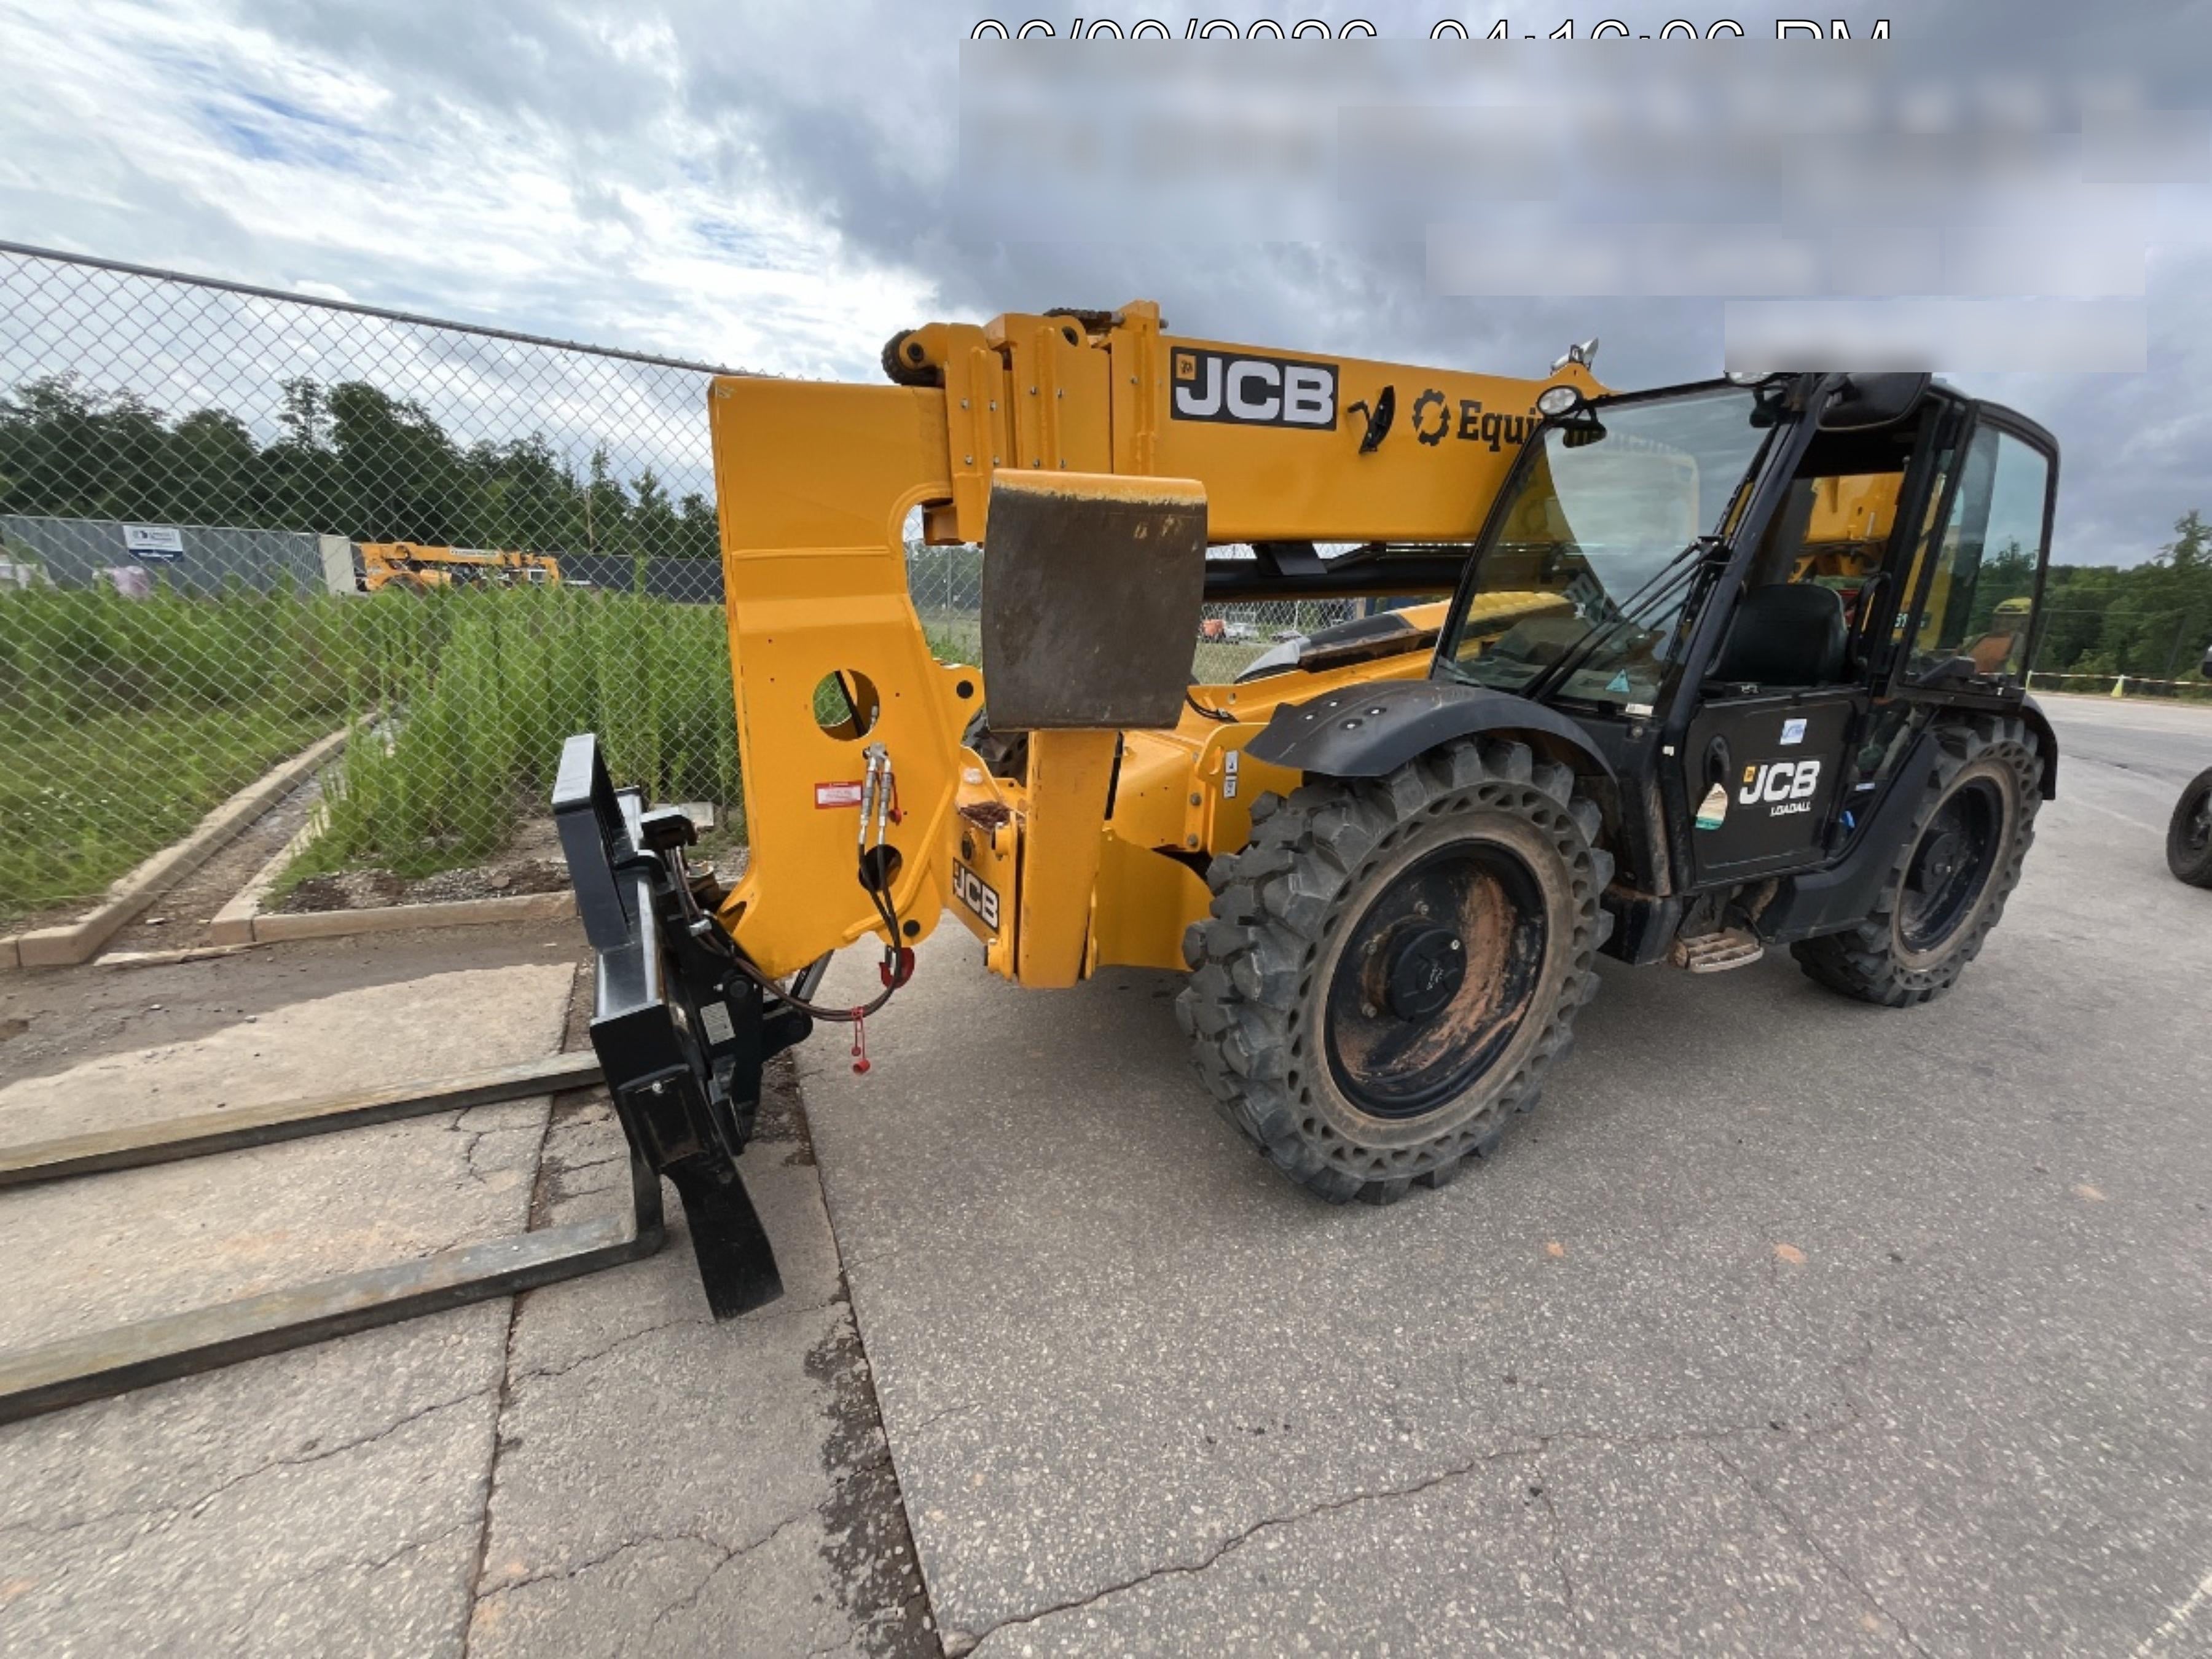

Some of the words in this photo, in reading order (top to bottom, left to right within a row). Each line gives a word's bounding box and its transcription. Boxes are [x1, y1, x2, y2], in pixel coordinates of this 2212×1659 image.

[1175, 357, 1334, 424] JCB
[1457, 399, 1543, 452] Equi
[1739, 761, 1821, 804] JCB
[1770, 801, 1811, 817] LOADALL
[954, 866, 998, 928] JCB
